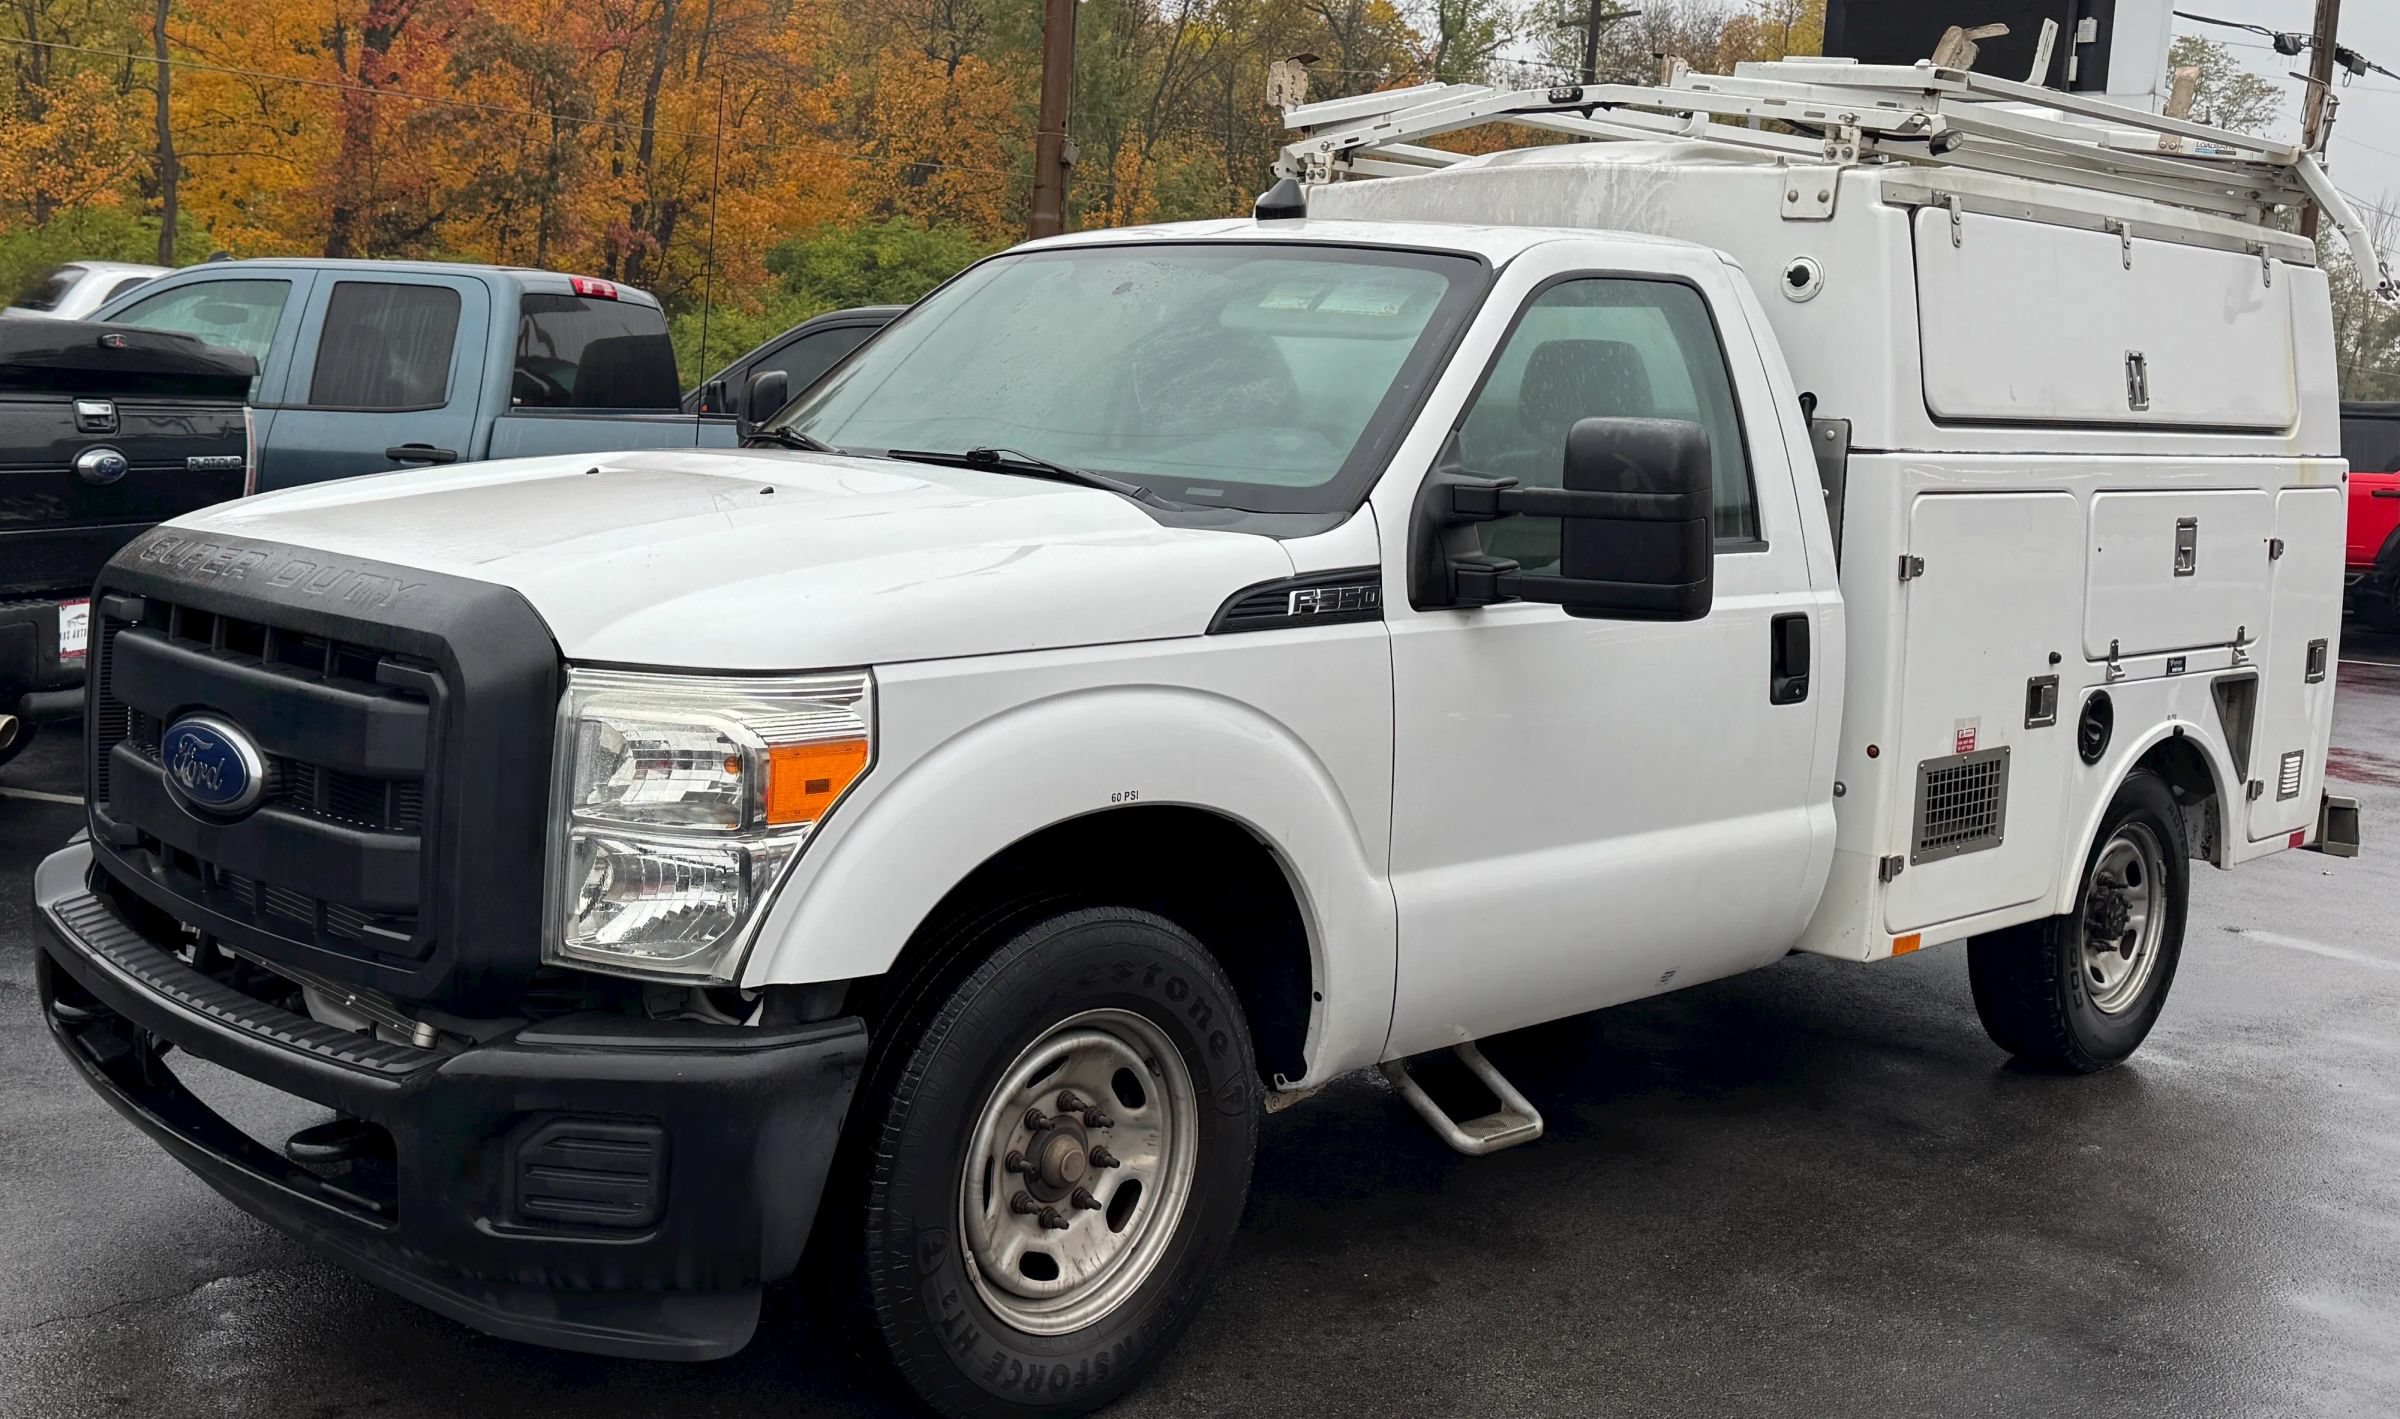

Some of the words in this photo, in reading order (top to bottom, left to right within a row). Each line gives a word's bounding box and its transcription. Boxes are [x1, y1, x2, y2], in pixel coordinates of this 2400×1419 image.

[188, 456, 242, 471] PLATINUM
[141, 536, 268, 580] SUPER
[265, 558, 428, 607] DUTY
[174, 732, 225, 791] Ford
[1111, 792, 1121, 803] 60
[1124, 789, 1139, 801] PSI
[1072, 958, 1231, 1062] estone
